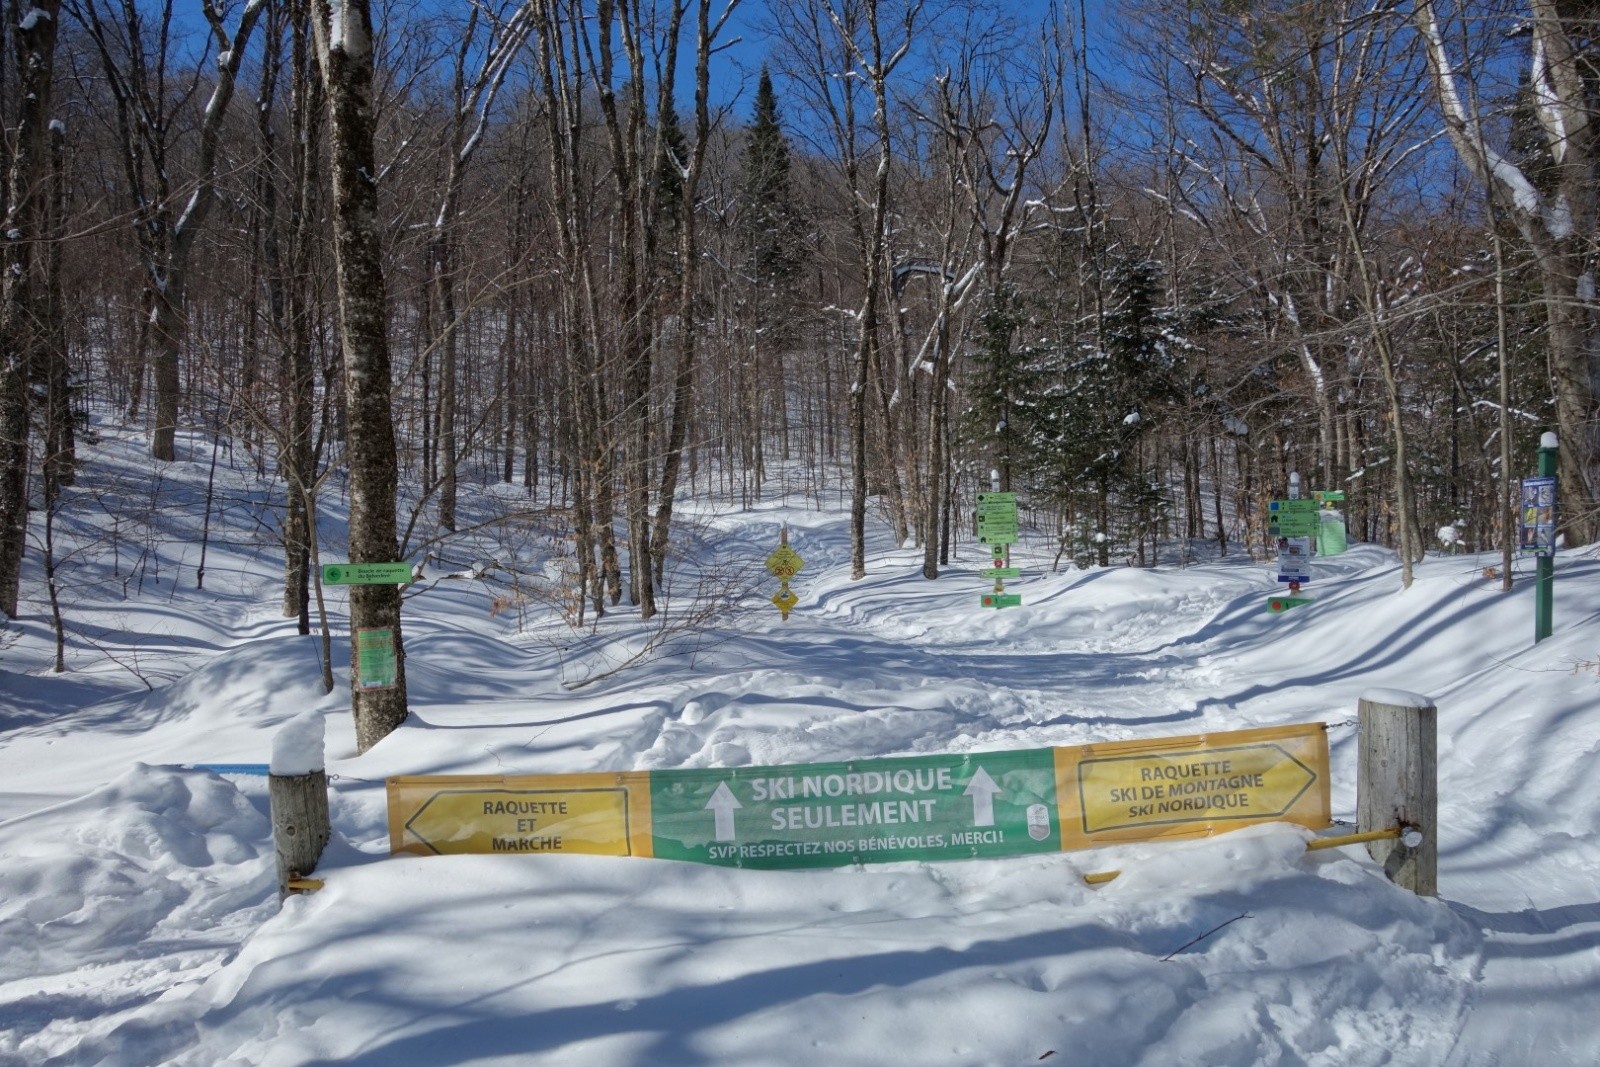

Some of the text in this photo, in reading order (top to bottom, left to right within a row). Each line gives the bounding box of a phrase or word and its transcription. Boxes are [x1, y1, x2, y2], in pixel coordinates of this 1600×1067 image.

[1141, 760, 1231, 781] RAQUETTE
[752, 767, 953, 801] SKI NORDIQUE
[1110, 773, 1264, 802] SKI DE MONTAGNE
[483, 801, 568, 815] RAQUETTE
[771, 799, 937, 830] SEULEMENT
[1129, 793, 1249, 818] SKI NORDIQUE
[517, 819, 536, 832] ET
[492, 836, 562, 851] MARCHE
[709, 846, 737, 859] SVP
[740, 842, 822, 858] RESPECTEZ
[824, 840, 855, 853] NOS
[858, 834, 948, 852] BÉNÉVOLES,
